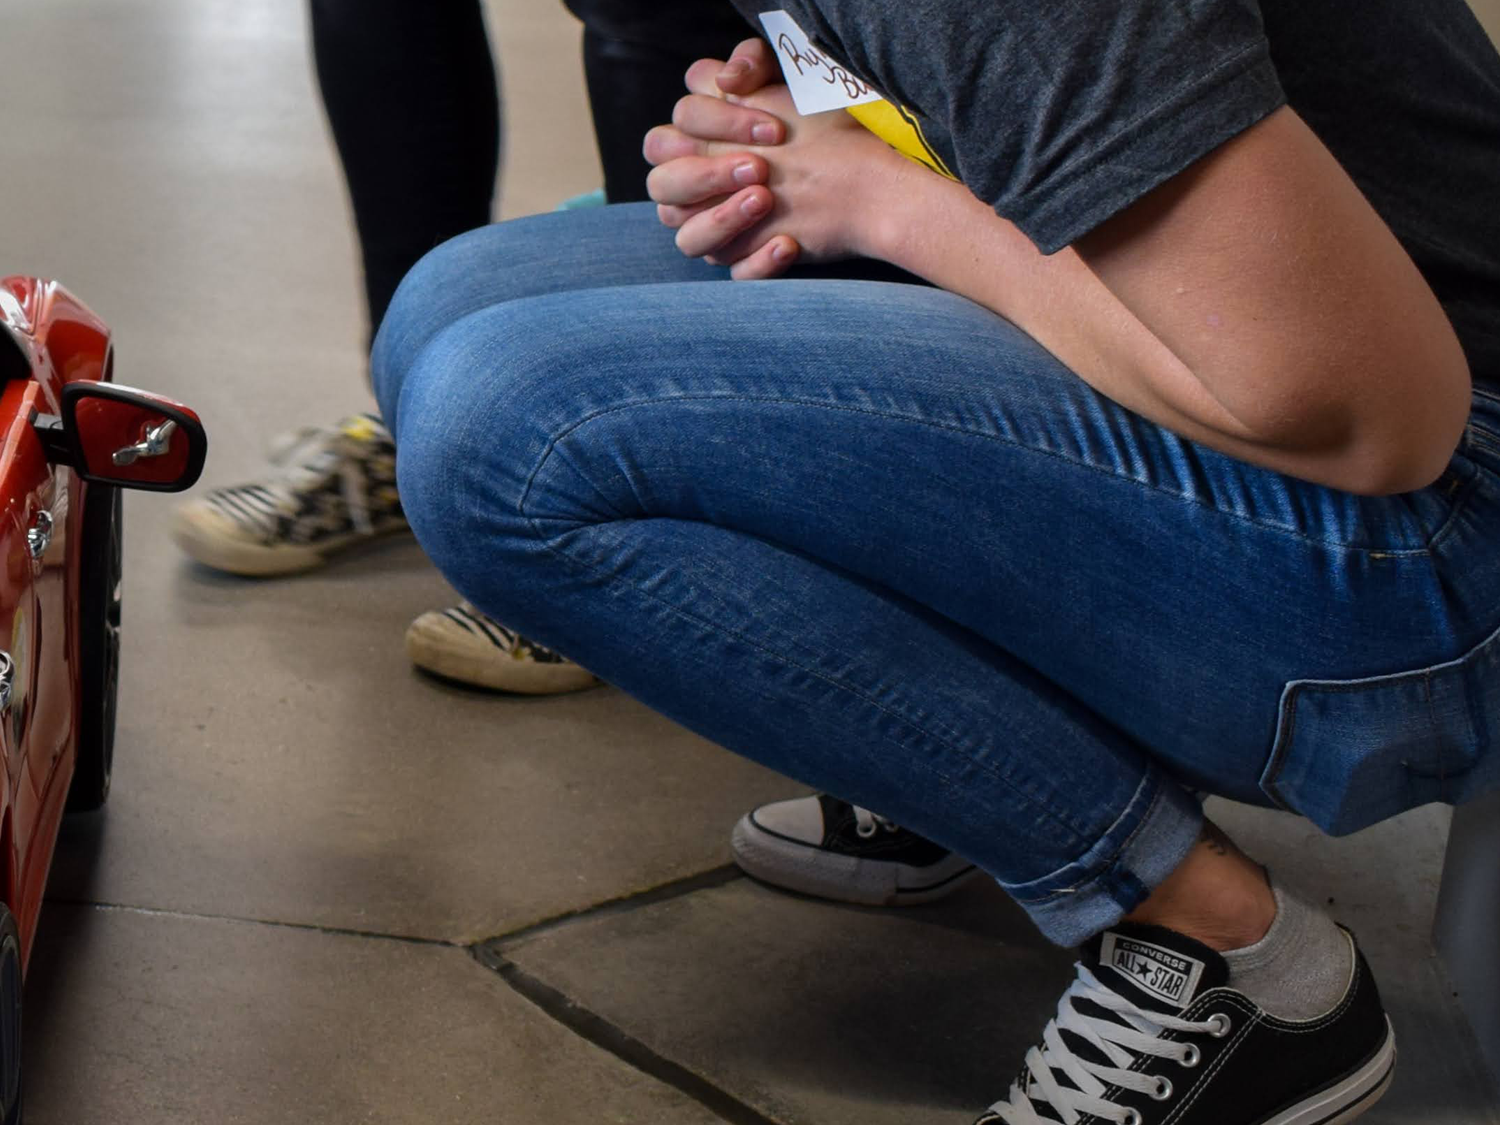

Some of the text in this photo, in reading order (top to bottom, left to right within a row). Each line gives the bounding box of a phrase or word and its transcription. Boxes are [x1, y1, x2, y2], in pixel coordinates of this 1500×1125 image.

[778, 32, 836, 84] Ry
[1116, 950, 1184, 996] ALL STAR
[1122, 941, 1188, 971] CONVERSE
